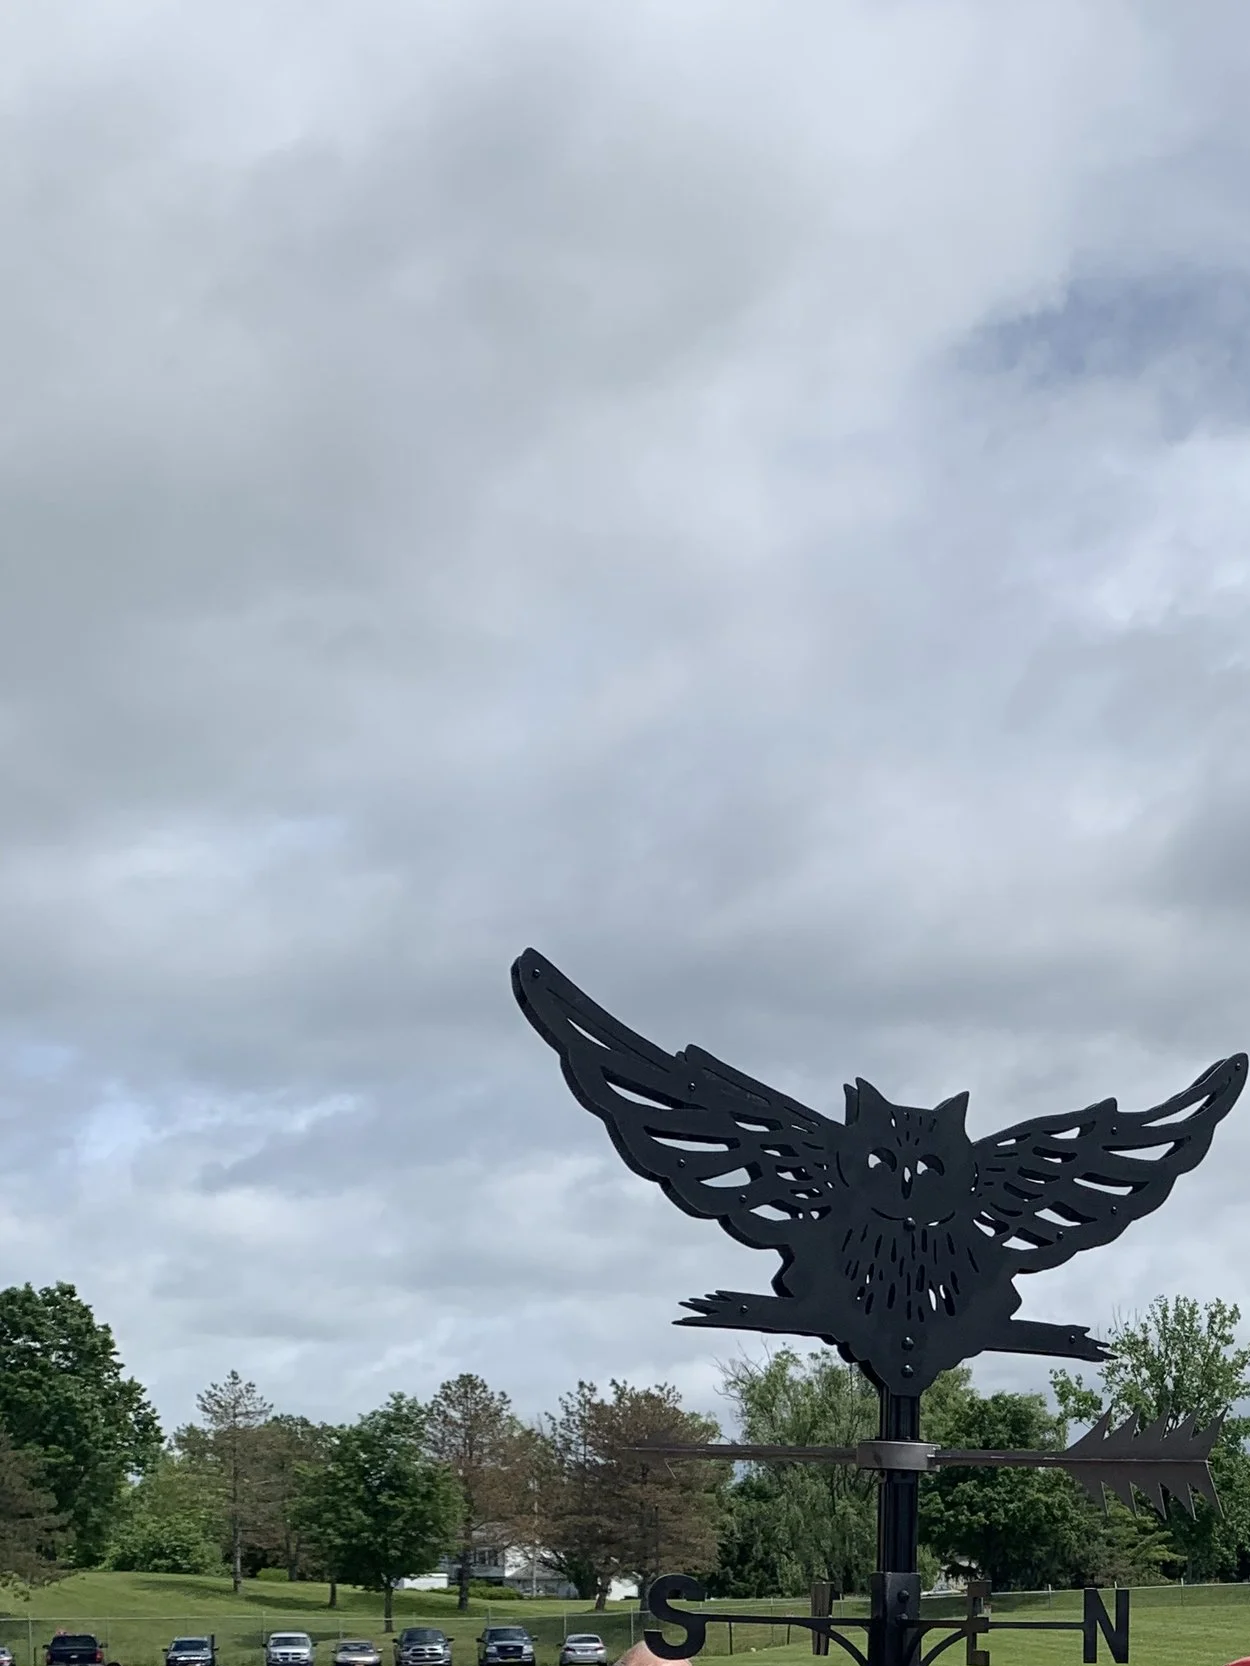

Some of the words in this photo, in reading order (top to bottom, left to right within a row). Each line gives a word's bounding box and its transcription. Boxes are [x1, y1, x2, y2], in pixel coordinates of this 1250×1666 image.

[644, 1574, 706, 1660] S
[967, 1580, 991, 1666] E
[1083, 1588, 1130, 1664] N
